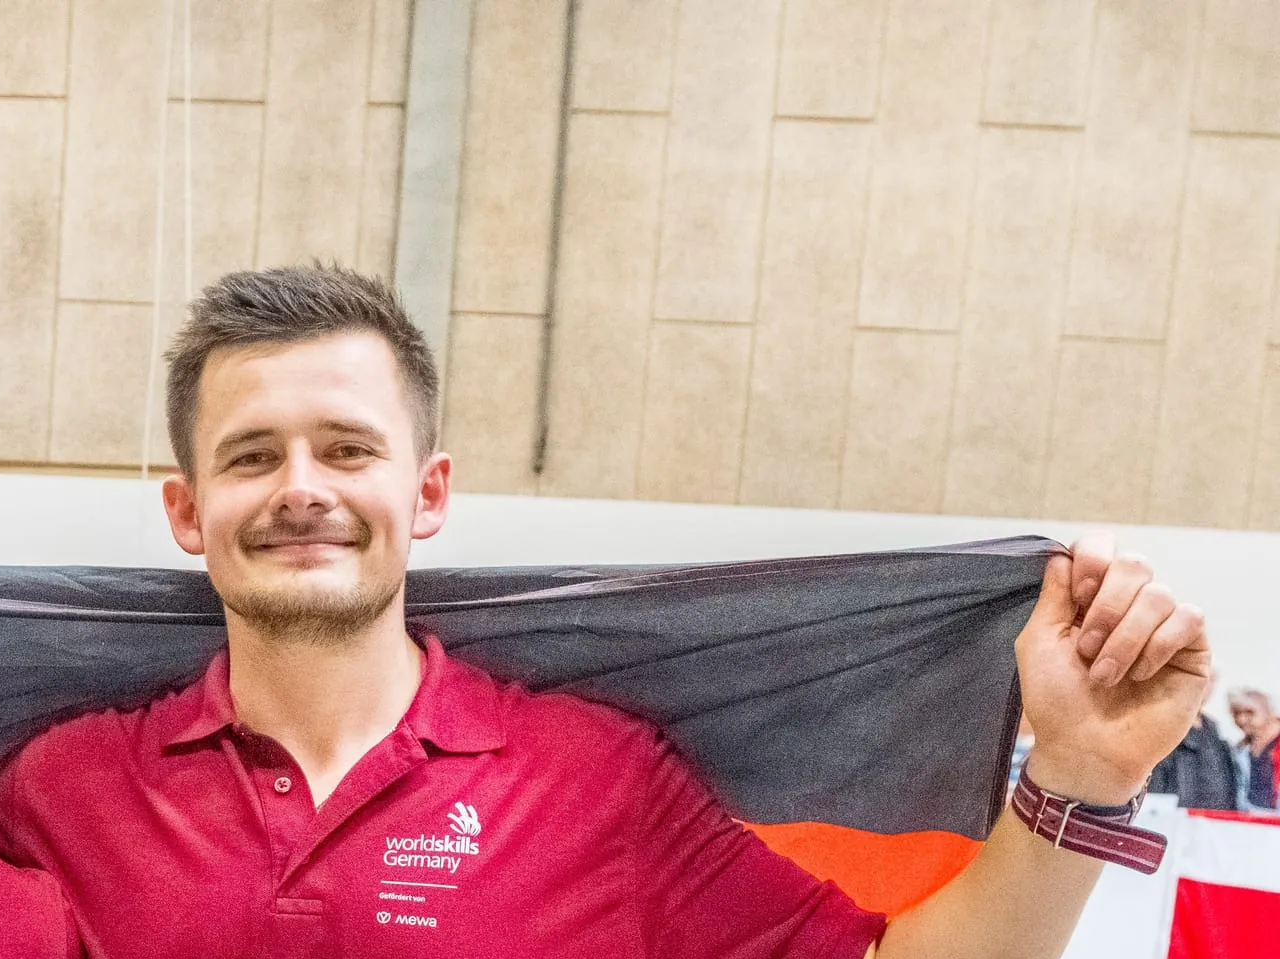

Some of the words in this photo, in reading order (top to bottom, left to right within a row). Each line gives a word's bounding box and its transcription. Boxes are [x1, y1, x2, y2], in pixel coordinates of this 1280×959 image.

[385, 834, 480, 855] worldskills
[383, 849, 461, 874] Germany
[379, 892, 412, 902] Gefördert
[413, 895, 426, 903] von
